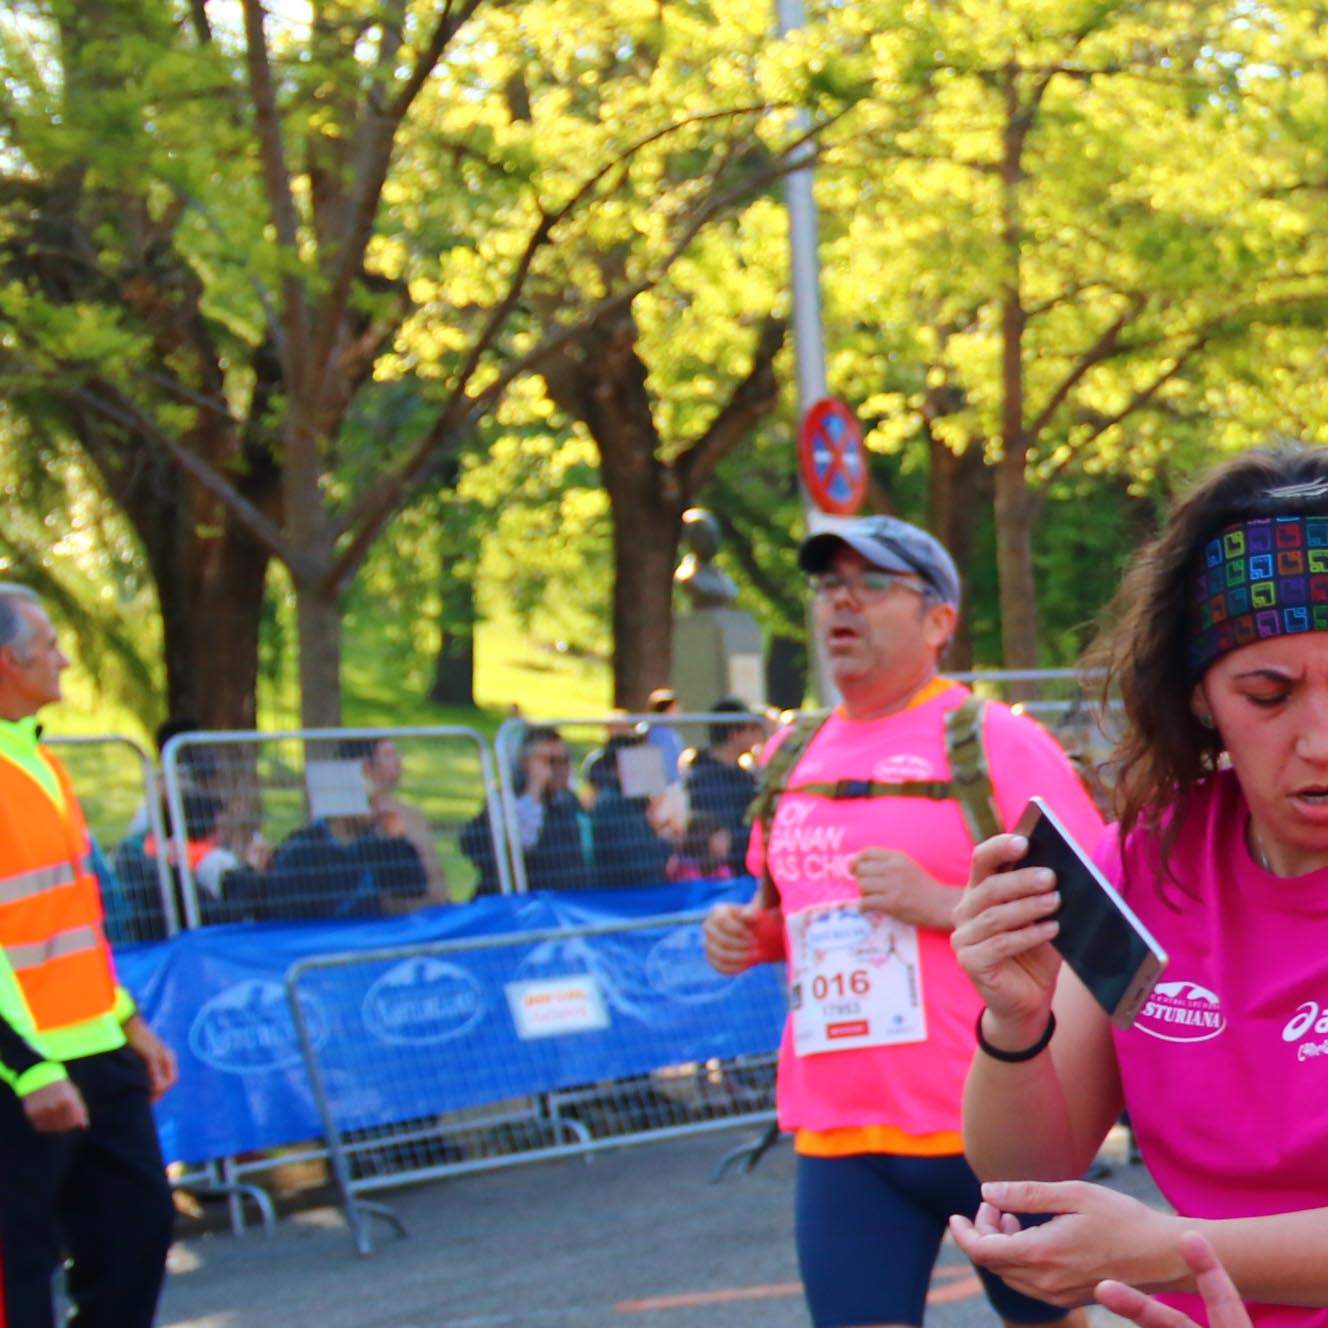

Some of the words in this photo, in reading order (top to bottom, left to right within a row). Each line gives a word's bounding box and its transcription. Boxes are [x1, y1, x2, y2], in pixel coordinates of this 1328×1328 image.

[779, 801, 817, 828] OY
[774, 852, 801, 882] AS
[811, 969, 872, 1001] 016
[1140, 1001, 1222, 1030] STURIANA
